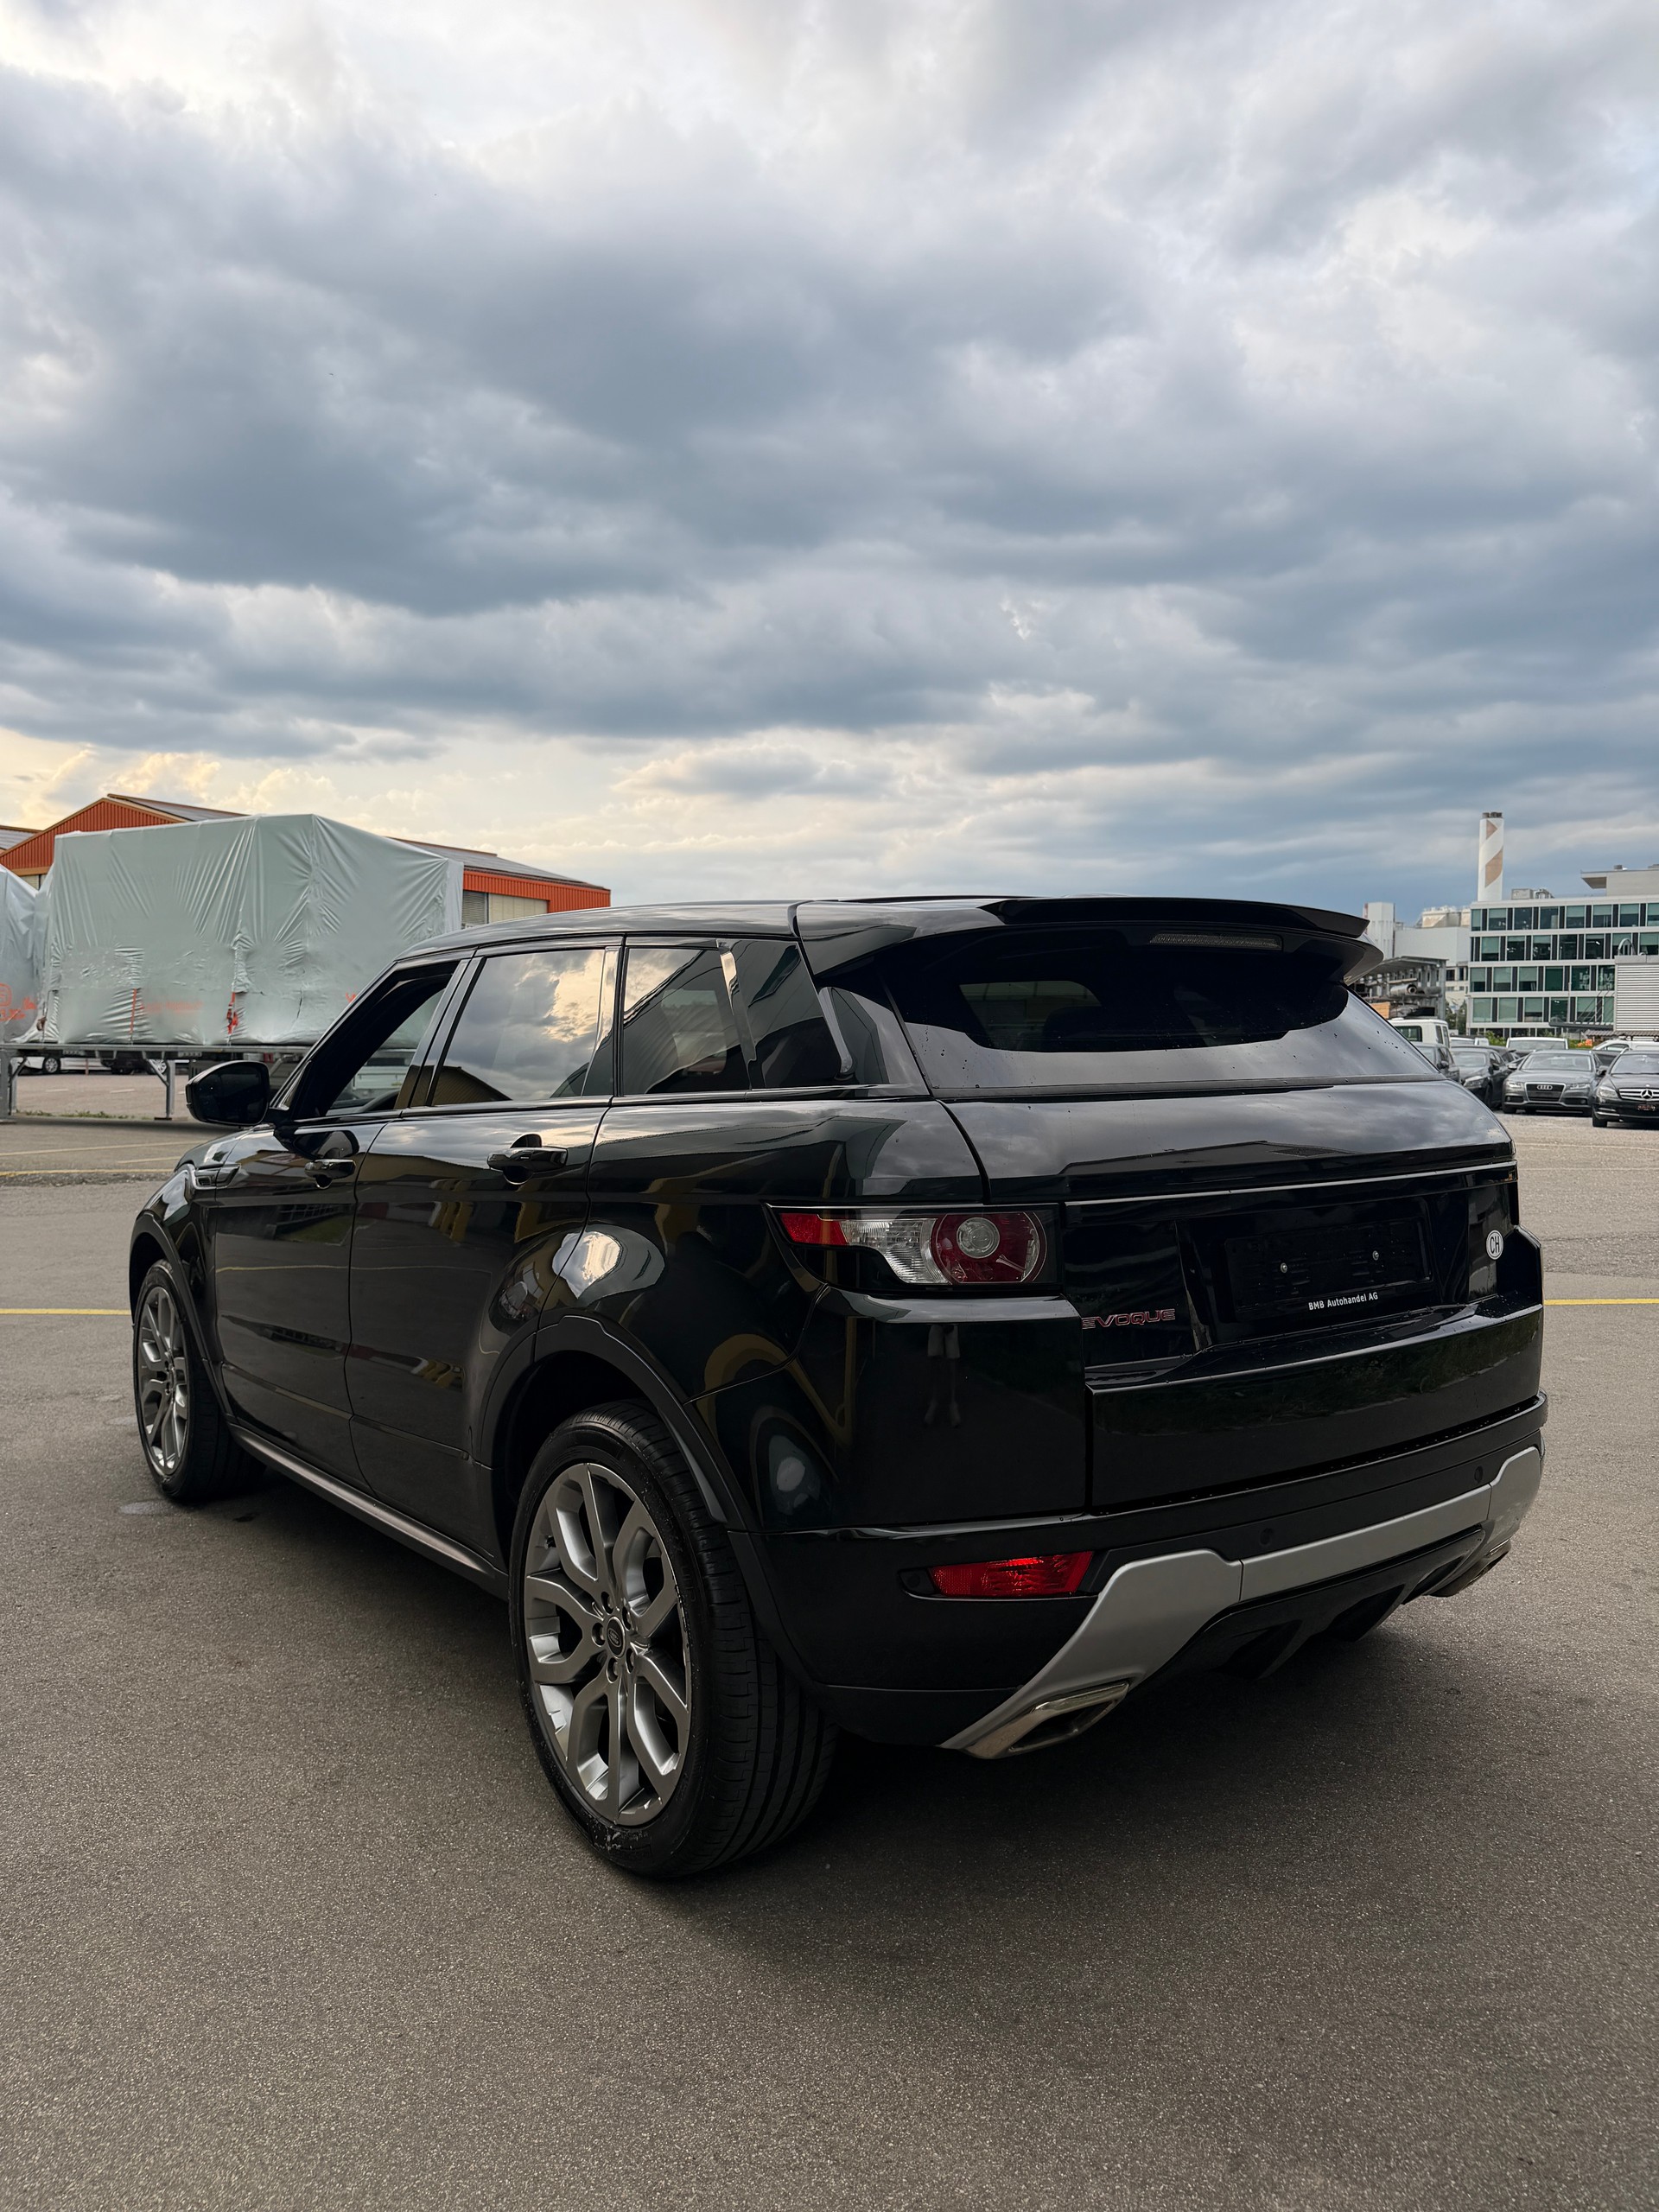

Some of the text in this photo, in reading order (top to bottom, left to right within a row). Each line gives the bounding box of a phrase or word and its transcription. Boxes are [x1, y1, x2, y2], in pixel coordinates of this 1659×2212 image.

[1490, 1236, 1500, 1254] CH
[1308, 1292, 1378, 1311] BMB Autohandel AG
[1081, 1308, 1176, 1330] EVOQUE
